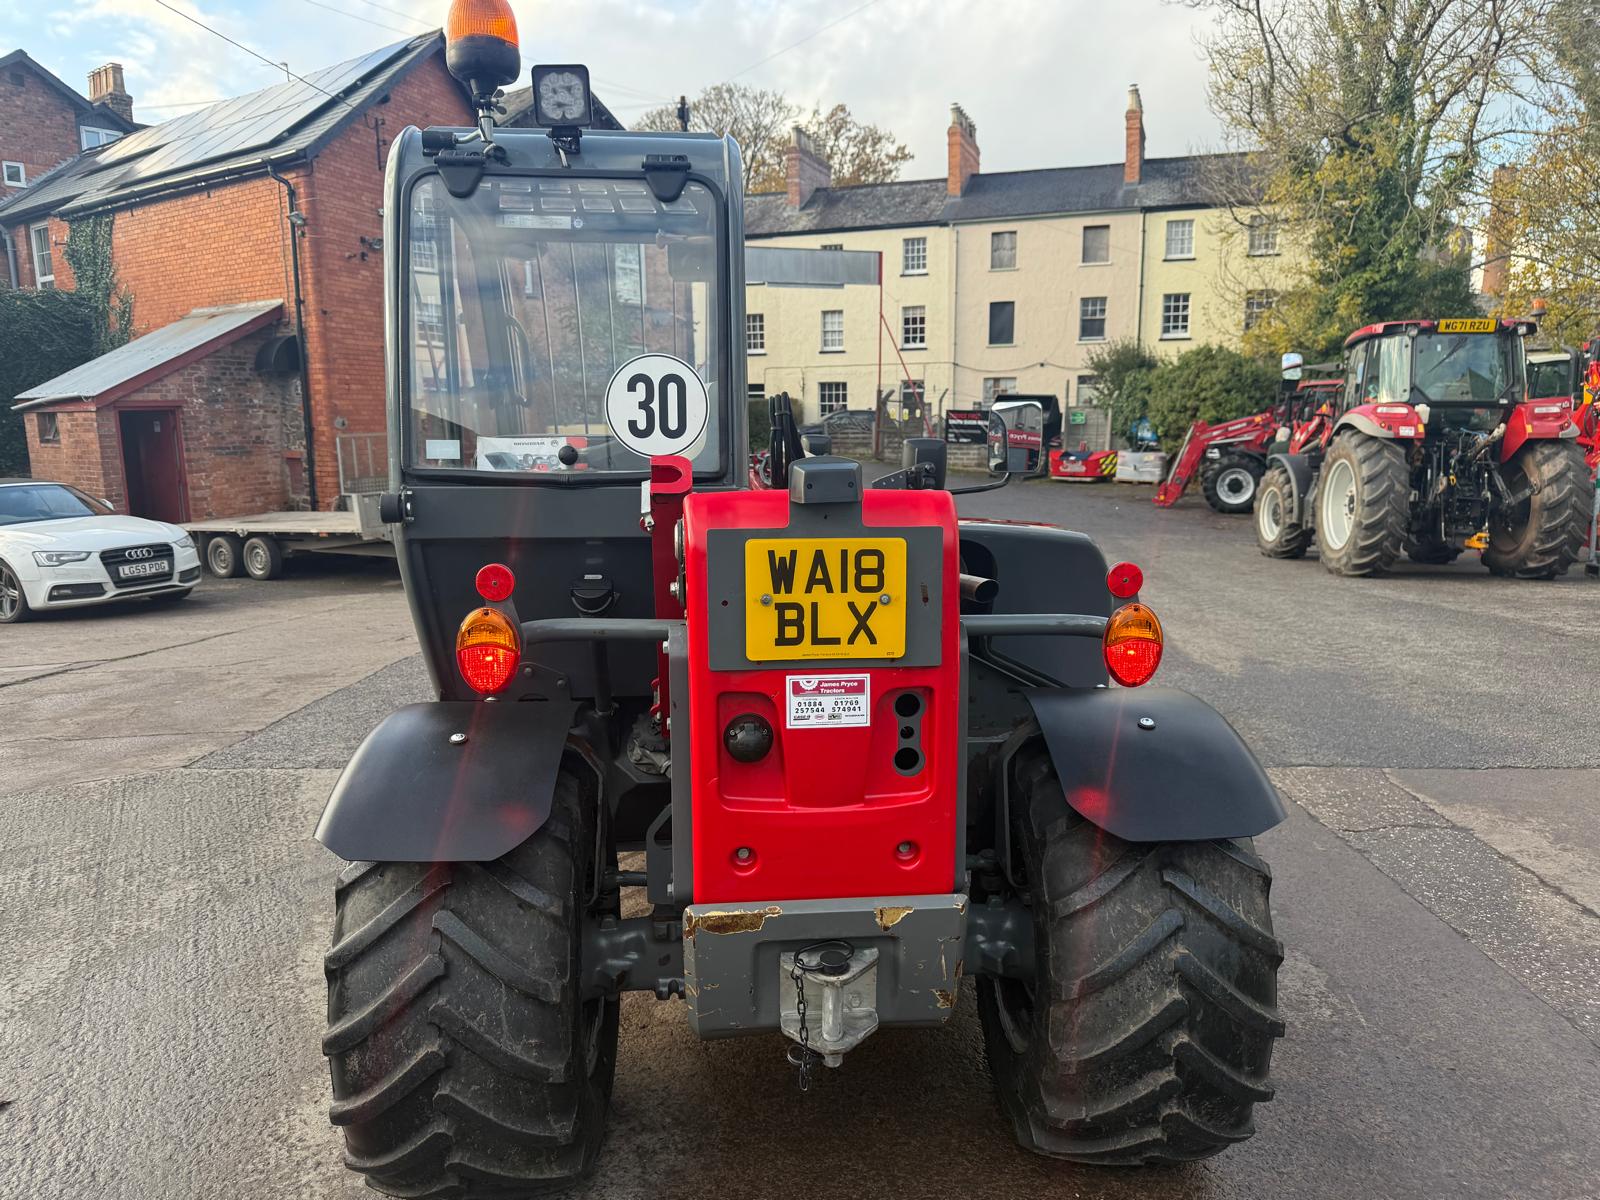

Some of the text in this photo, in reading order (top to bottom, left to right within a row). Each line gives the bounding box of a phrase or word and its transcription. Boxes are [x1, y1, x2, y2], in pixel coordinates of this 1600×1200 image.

[1444, 321, 1490, 330] WG71 RZU
[627, 373, 687, 439] 30
[122, 561, 166, 576] LG59 PDG
[767, 548, 885, 594] WA18
[774, 601, 878, 647] BLX
